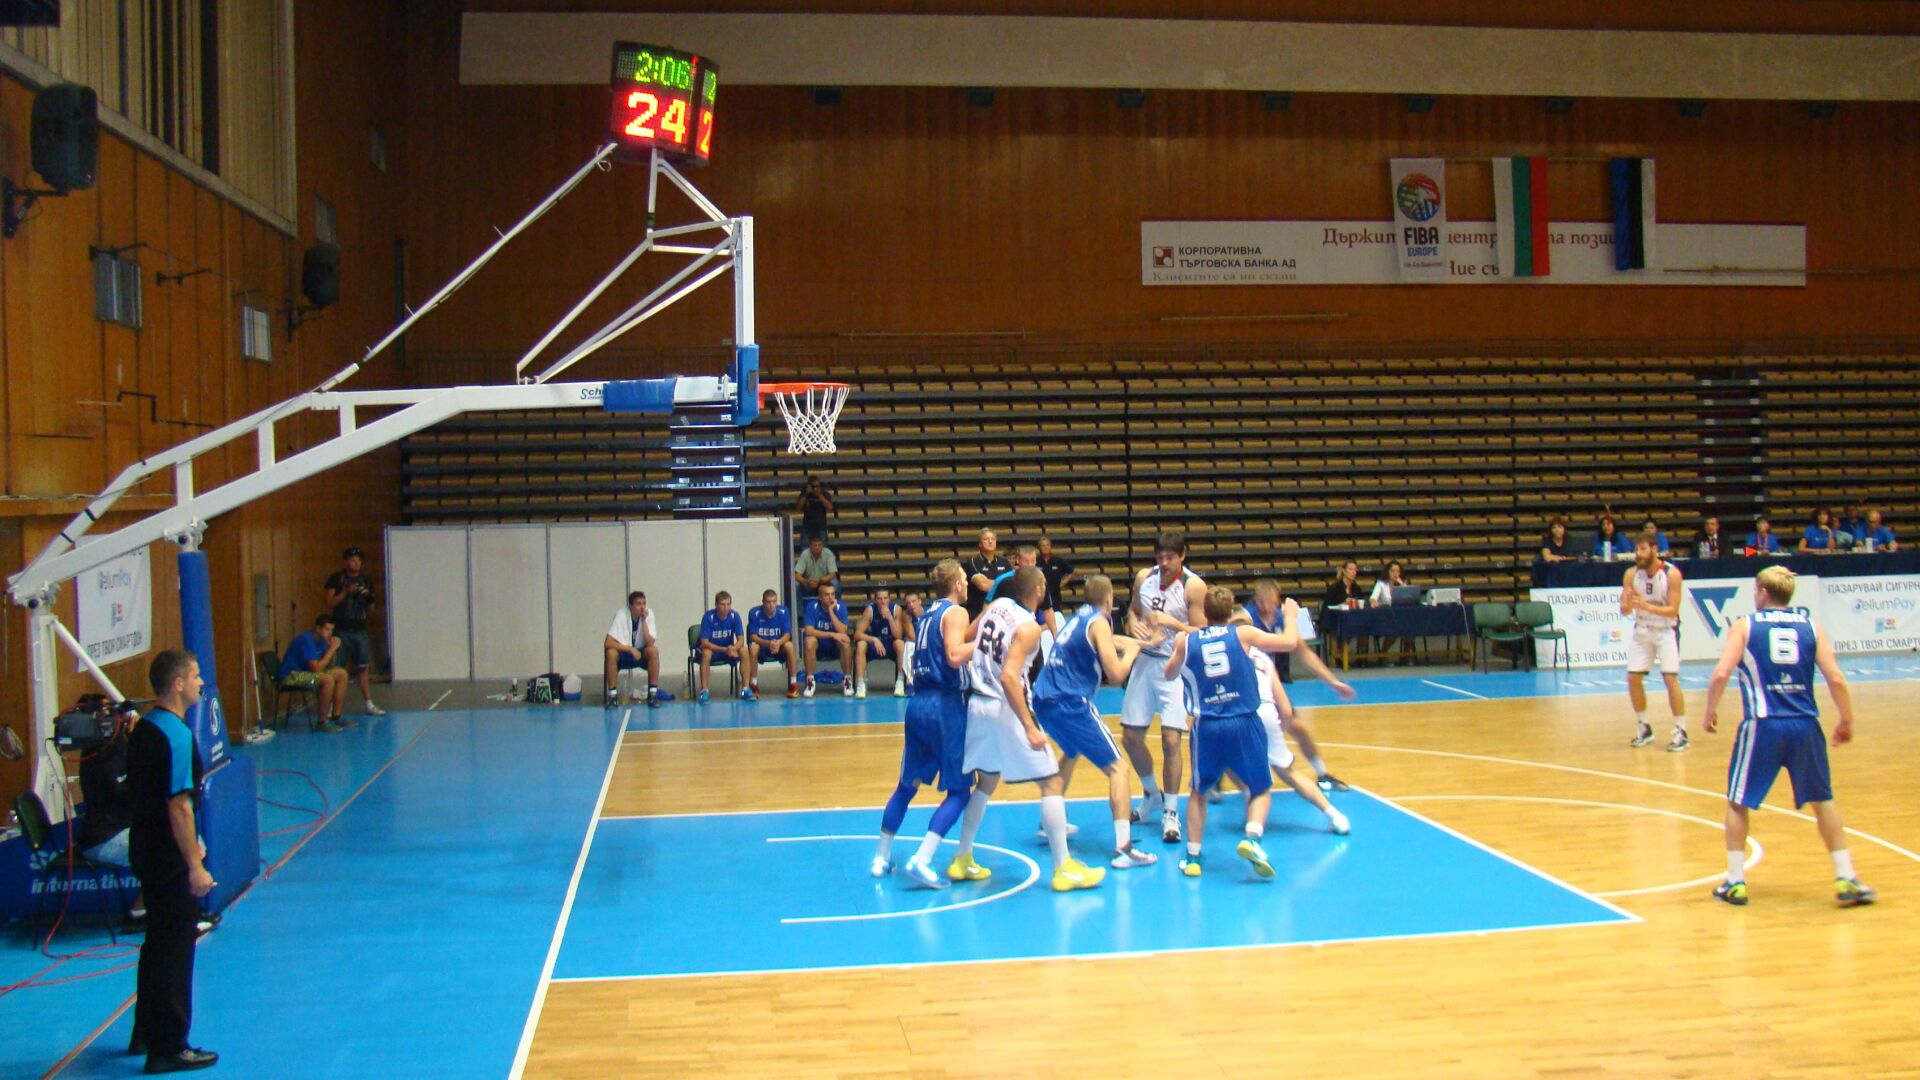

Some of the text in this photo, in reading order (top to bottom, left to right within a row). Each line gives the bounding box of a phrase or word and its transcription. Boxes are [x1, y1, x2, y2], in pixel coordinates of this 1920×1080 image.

[635, 51, 690, 89] 2:06
[625, 91, 686, 143] 24
[1404, 226, 1439, 245] FIBA
[1179, 246, 1262, 256] КОРПОРАТИВНА
[1179, 258, 1297, 269] ТЪРГОВСКА БАНКА АД
[1408, 246, 1438, 257] EUROPE
[1201, 640, 1231, 678] 5
[1769, 628, 1800, 665] 6
